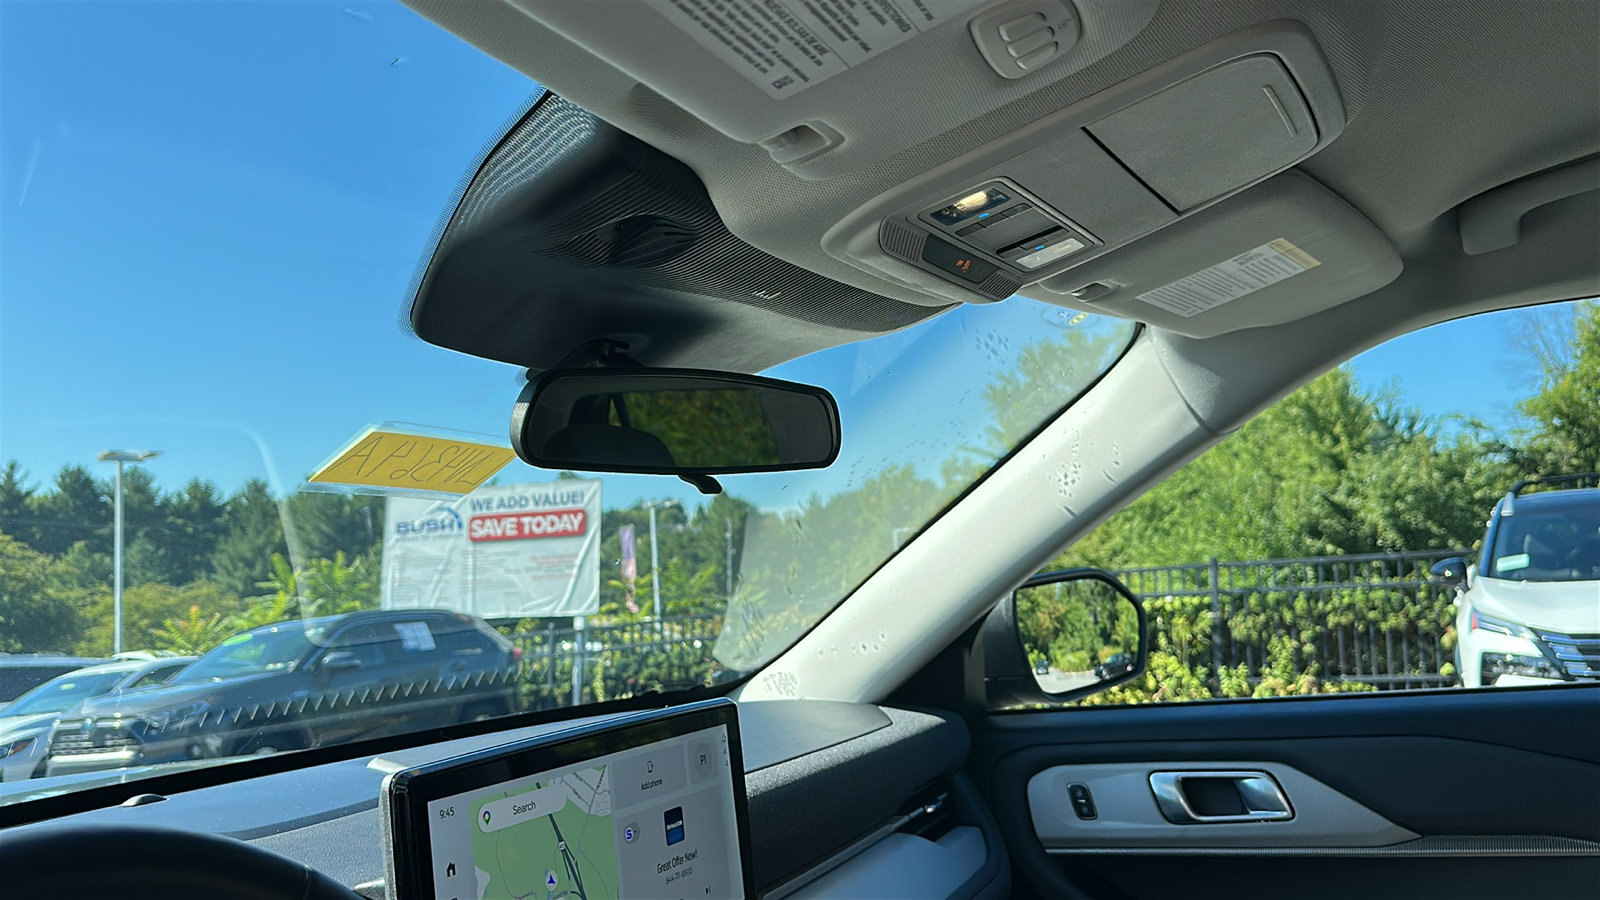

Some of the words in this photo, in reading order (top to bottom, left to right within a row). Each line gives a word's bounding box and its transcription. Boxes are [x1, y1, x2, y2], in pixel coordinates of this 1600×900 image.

[471, 497, 494, 511] WE
[497, 495, 530, 508] ADD
[532, 490, 585, 506] VALUE!
[396, 518, 456, 535] BUSH
[471, 517, 518, 538] SAVE
[520, 511, 584, 535] TODAY
[440, 806, 455, 819] 9:45
[513, 801, 537, 816] Search
[657, 860, 672, 874] Great
[671, 855, 685, 868] Offer
